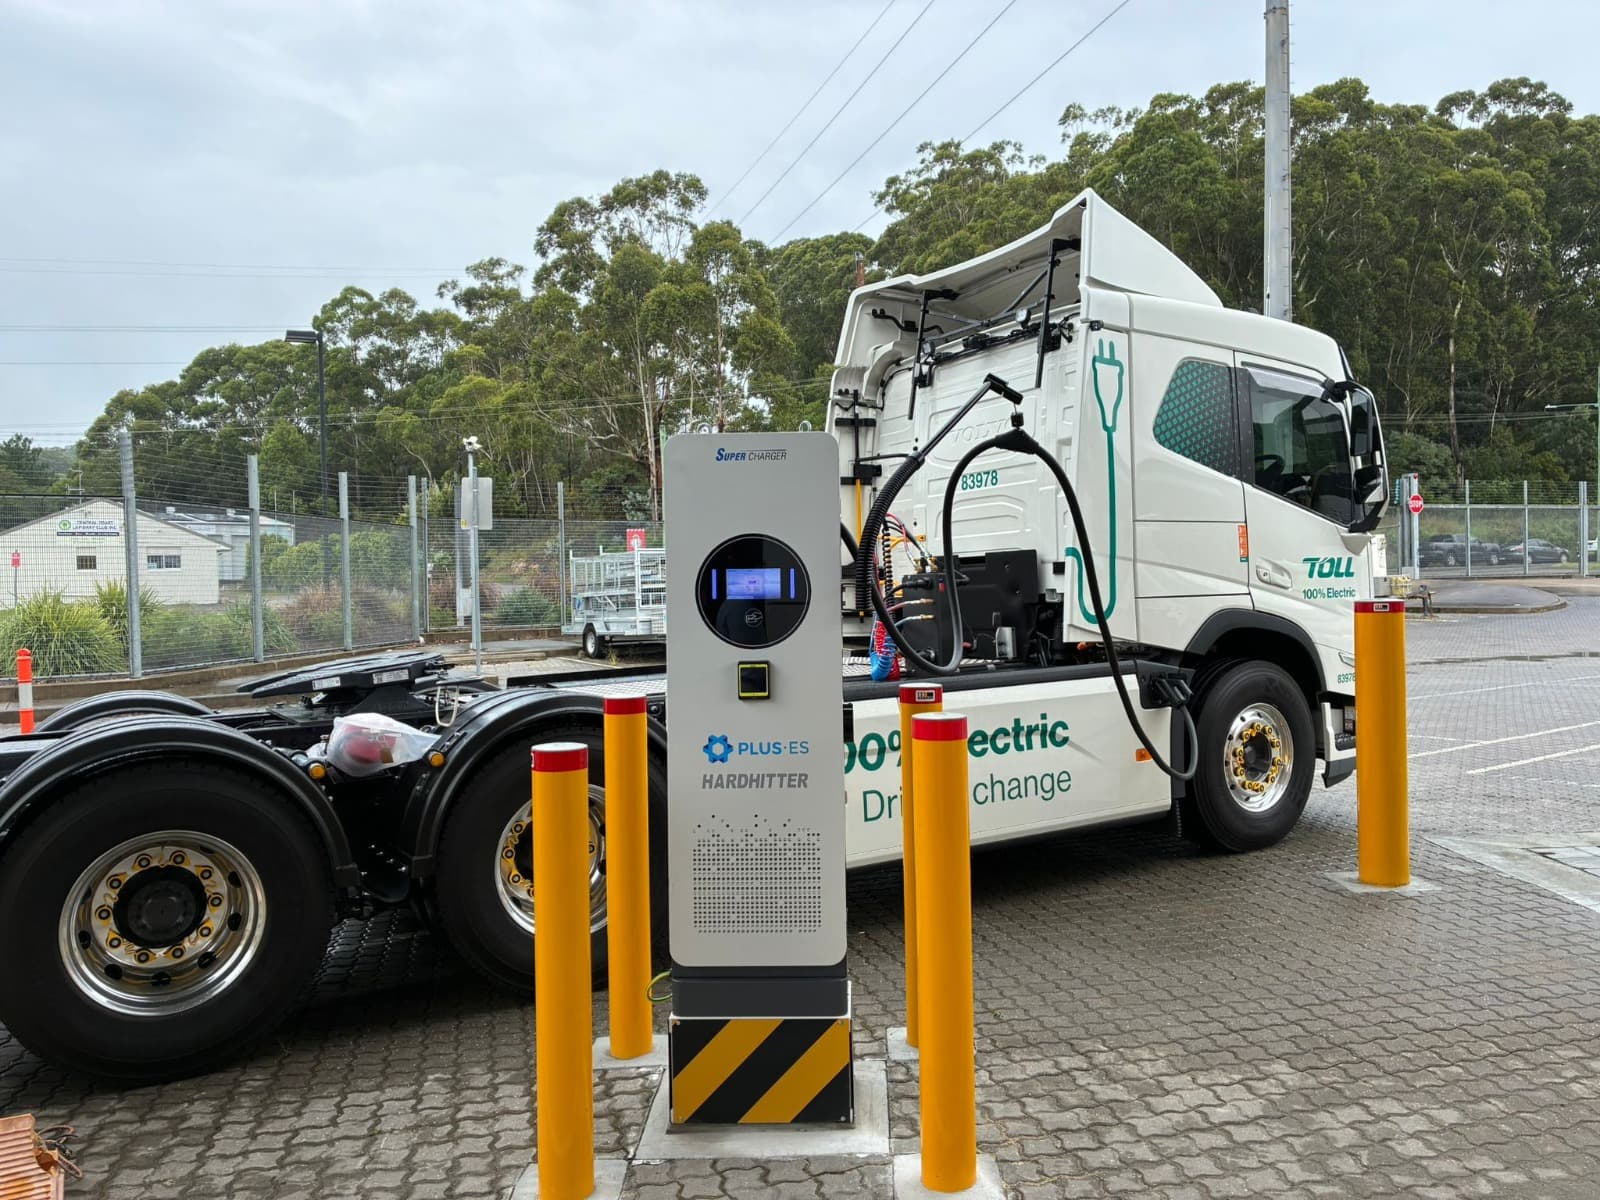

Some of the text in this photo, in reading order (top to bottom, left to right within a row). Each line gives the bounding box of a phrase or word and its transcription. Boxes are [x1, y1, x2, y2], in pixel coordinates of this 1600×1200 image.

[715, 447, 787, 461] SUPER CHARGER
[961, 470, 998, 491] 83978
[1302, 557, 1354, 579] TOLL
[1303, 586, 1356, 600] 100% Electric
[967, 713, 1069, 758] ectric
[702, 773, 808, 789] HARDHITTER
[973, 770, 1072, 805] change
